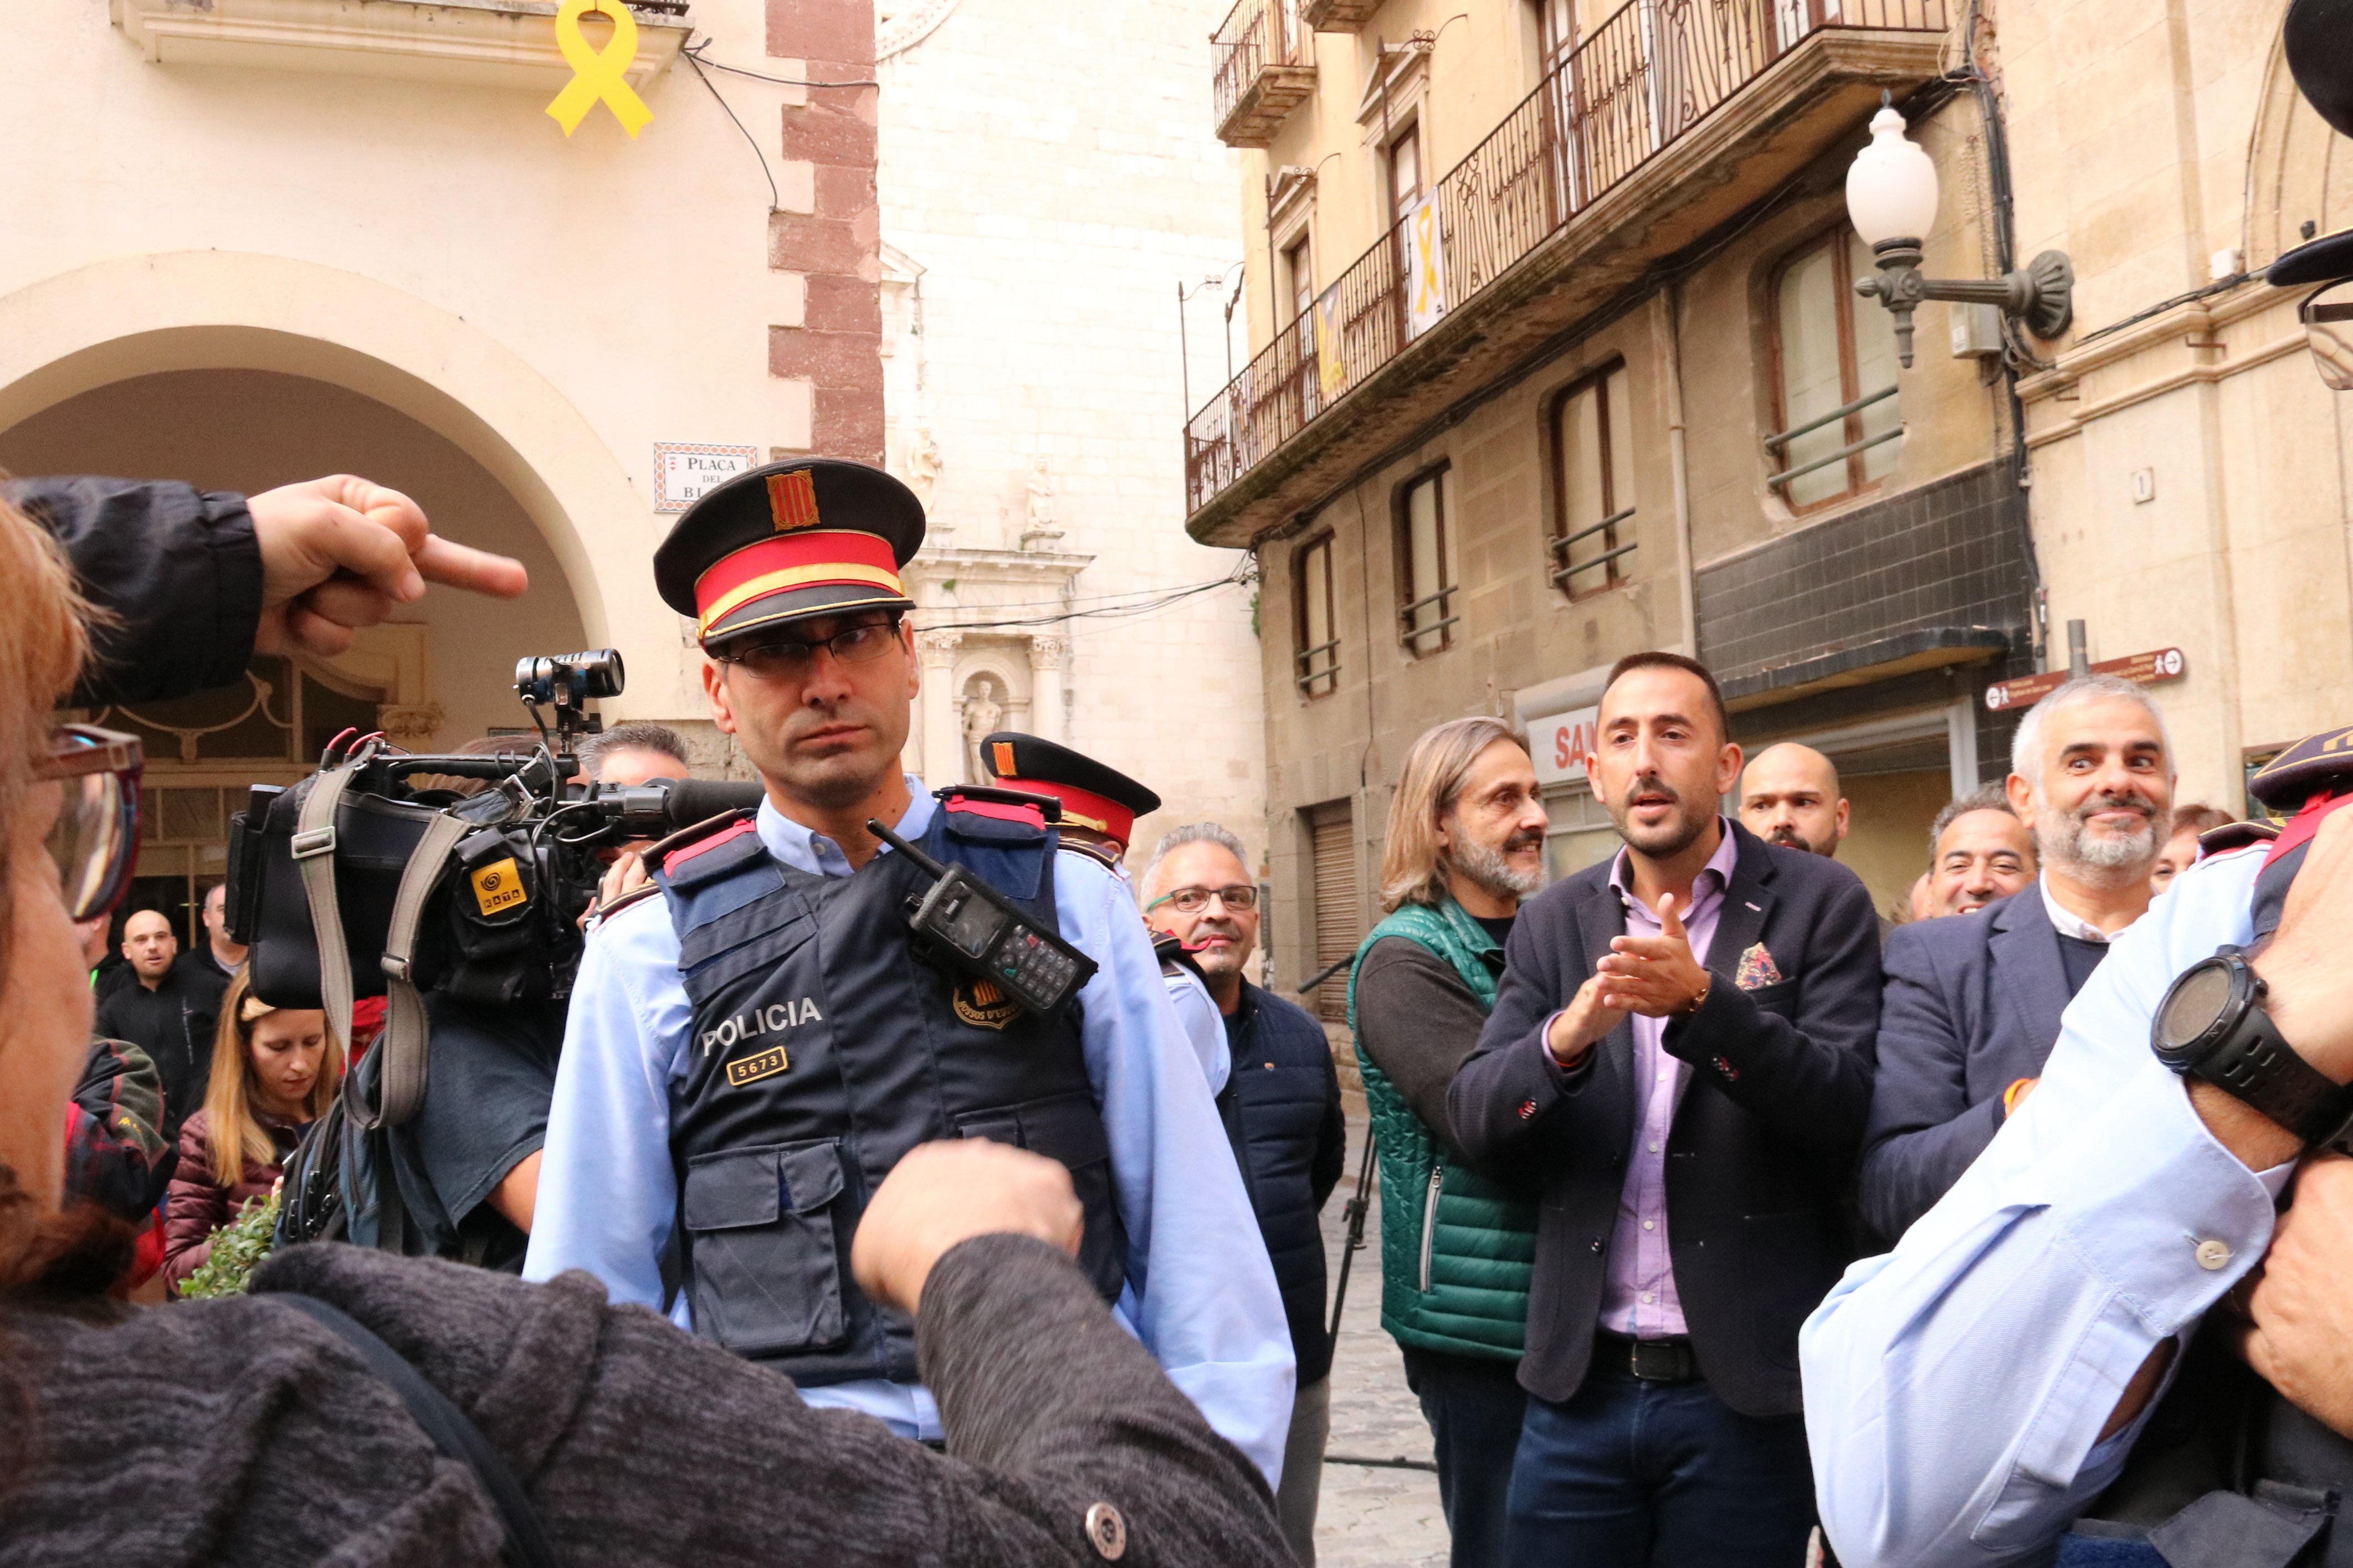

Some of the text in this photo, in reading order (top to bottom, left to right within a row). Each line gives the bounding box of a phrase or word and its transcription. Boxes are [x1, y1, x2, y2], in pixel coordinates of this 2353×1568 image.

[688, 457, 736, 471] PLAÇA
[484, 889, 520, 908] KATA
[701, 997, 823, 1057] POLICIA
[738, 1055, 778, 1077] 5673
